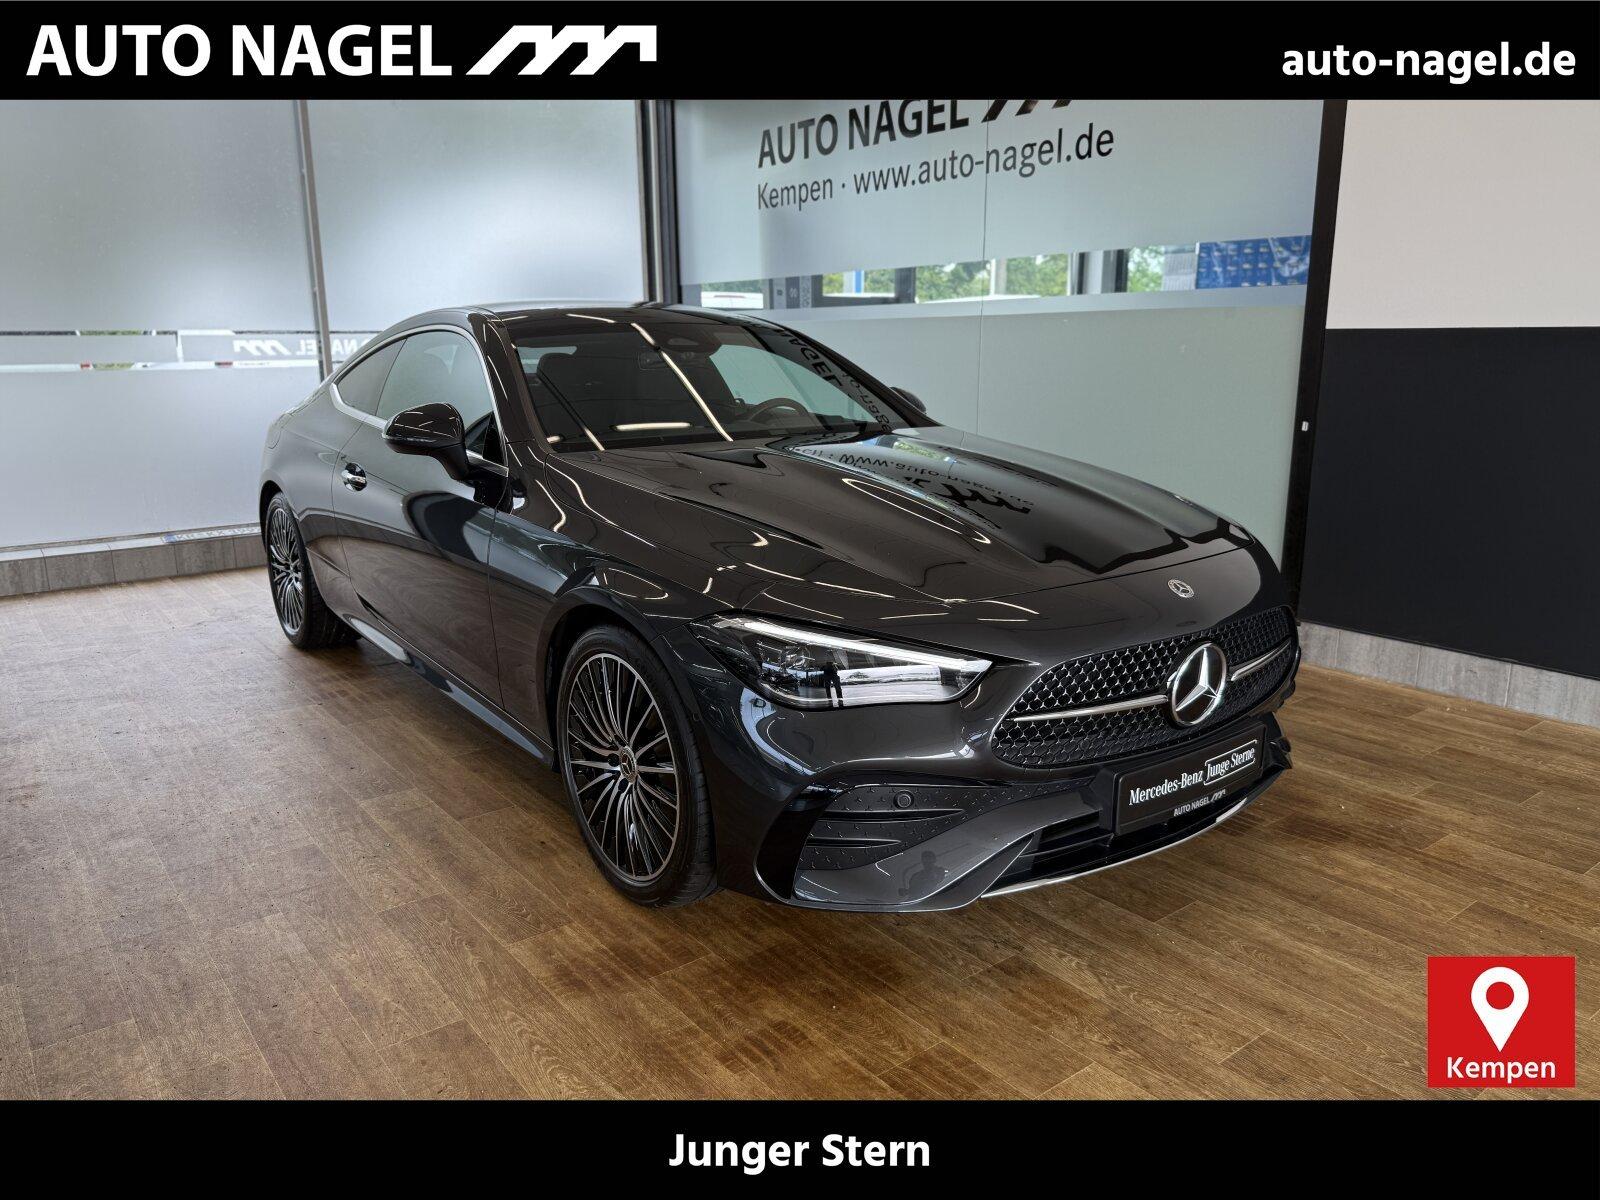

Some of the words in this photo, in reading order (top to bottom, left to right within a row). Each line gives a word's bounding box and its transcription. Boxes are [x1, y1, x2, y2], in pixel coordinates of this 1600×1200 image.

[757, 113, 838, 168] AUTO
[848, 100, 969, 151] NAGEL
[757, 178, 833, 212] Kempen
[853, 122, 1115, 195] www.auto-nagel.de
[1129, 769, 1204, 806] Mercedes-Benz
[1205, 760, 1230, 782] Junge
[1230, 747, 1255, 767] Sterne
[1173, 804, 1191, 817] AUTO
[1190, 796, 1210, 811] NAGEL
